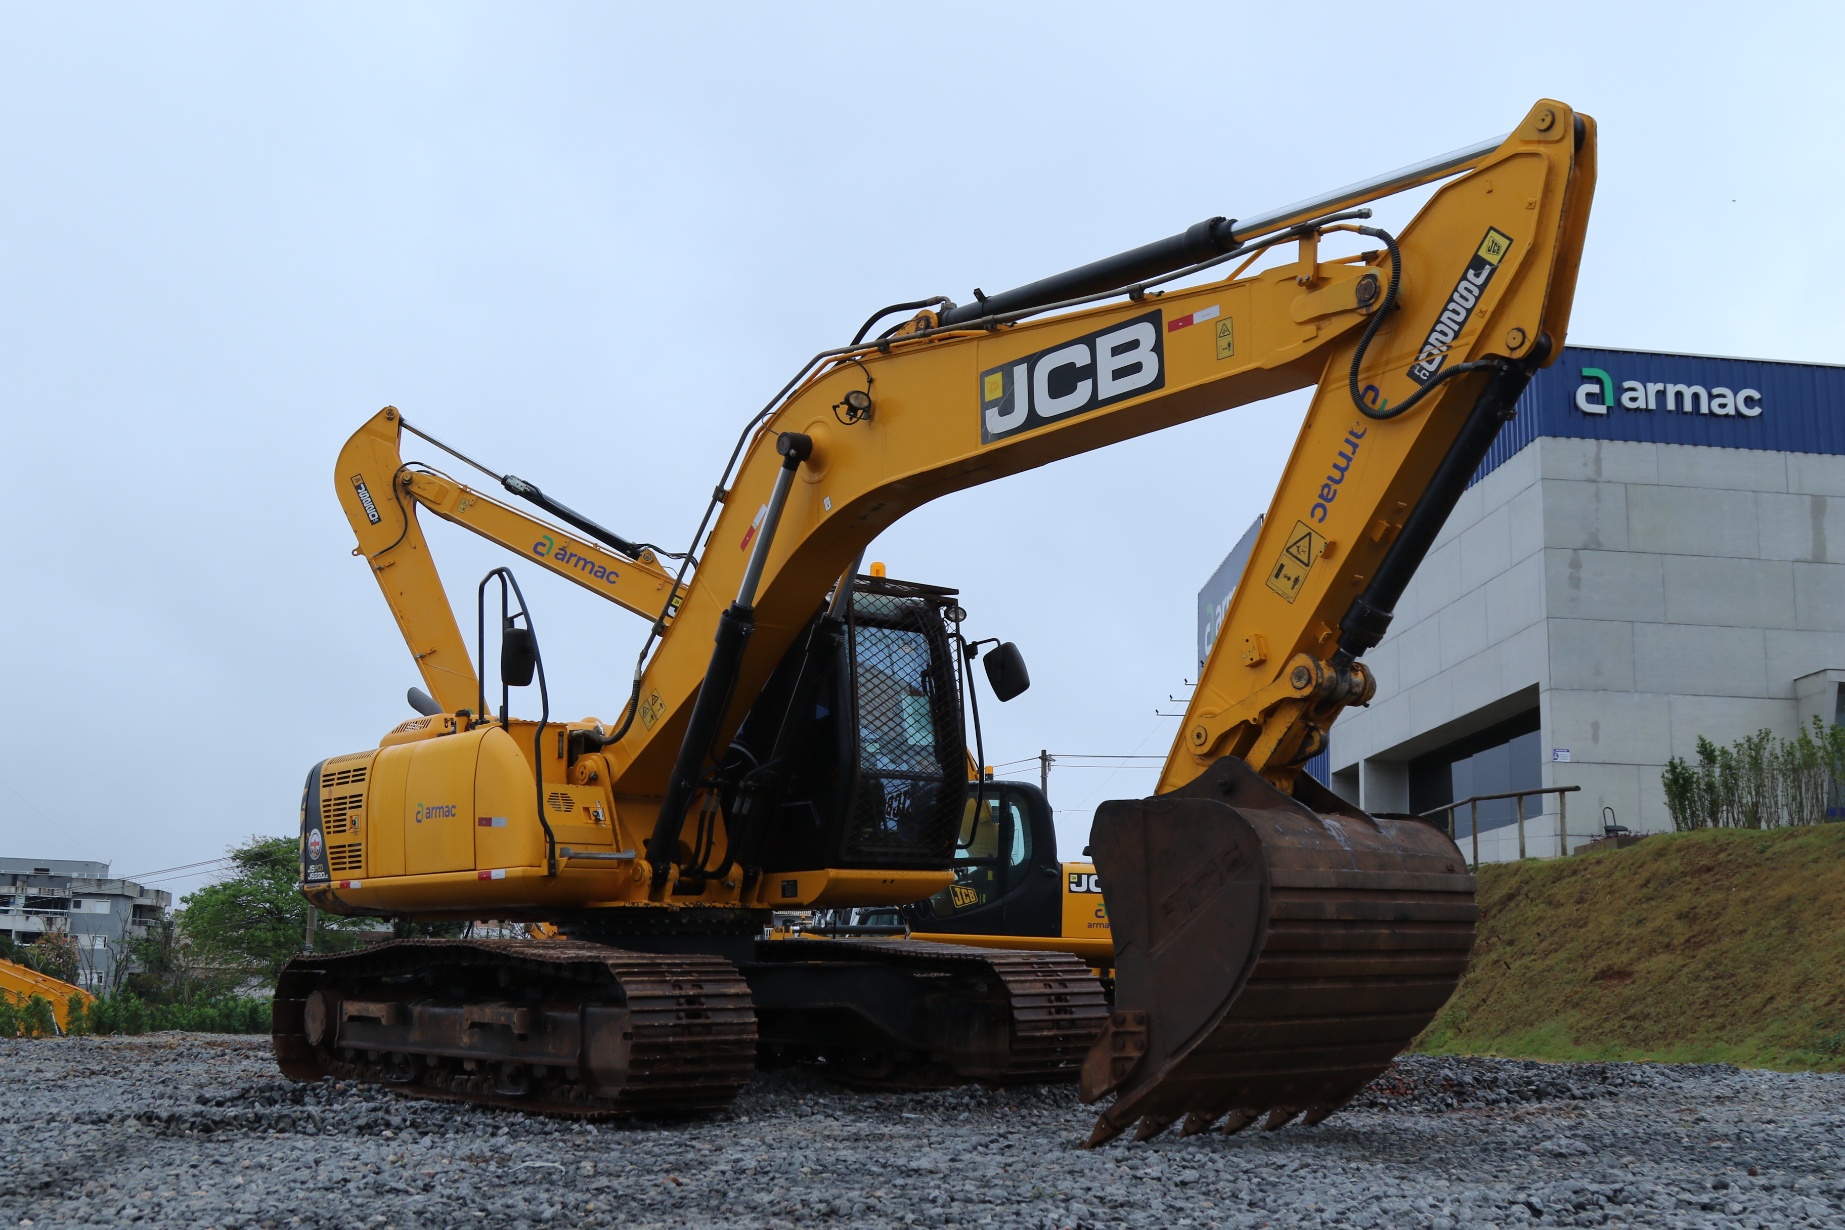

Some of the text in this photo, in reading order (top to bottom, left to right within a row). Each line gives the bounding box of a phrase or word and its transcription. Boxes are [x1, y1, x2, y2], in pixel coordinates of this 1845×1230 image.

[985, 321, 1159, 434] JCB
[1620, 380, 1763, 417] armac
[554, 546, 620, 585] armac
[425, 804, 457, 820] armac
[954, 887, 976, 906] JCB
[1070, 874, 1102, 893] JC
